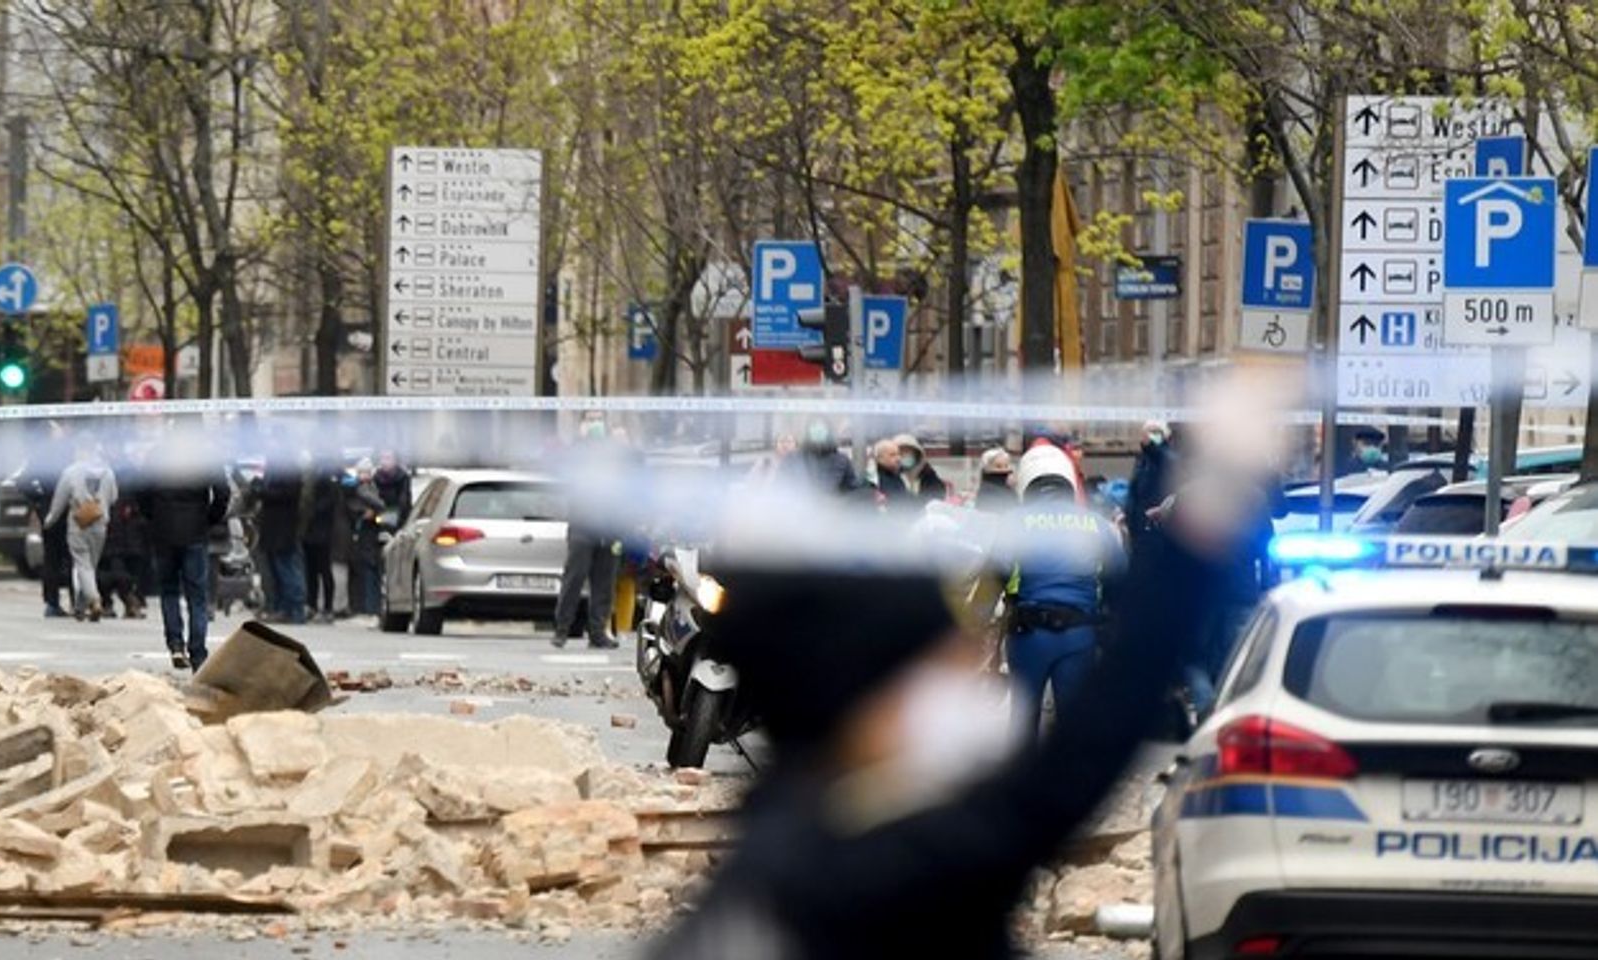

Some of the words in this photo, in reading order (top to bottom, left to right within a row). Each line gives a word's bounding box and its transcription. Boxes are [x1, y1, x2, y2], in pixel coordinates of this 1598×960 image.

[443, 160, 491, 174] Westin
[442, 189, 505, 202] Esplanade
[1475, 199, 1523, 267] P
[440, 251, 485, 266] Palace
[1264, 235, 1298, 289] P
[761, 248, 796, 299] P
[440, 283, 504, 298] Sheraton
[437, 315, 480, 330] Canopy
[483, 315, 497, 330] by
[500, 315, 533, 329] Hilton
[1464, 299, 1509, 323] 500
[1516, 304, 1533, 322] m
[94, 314, 110, 346] P
[867, 310, 890, 354] P
[437, 345, 489, 360] Central
[1347, 373, 1430, 398] Jadran
[1023, 513, 1099, 533] POLICIJA
[1395, 542, 1557, 564] POLICIJA
[1505, 783, 1557, 814] 307
[1376, 830, 1598, 863] POLICIJA
